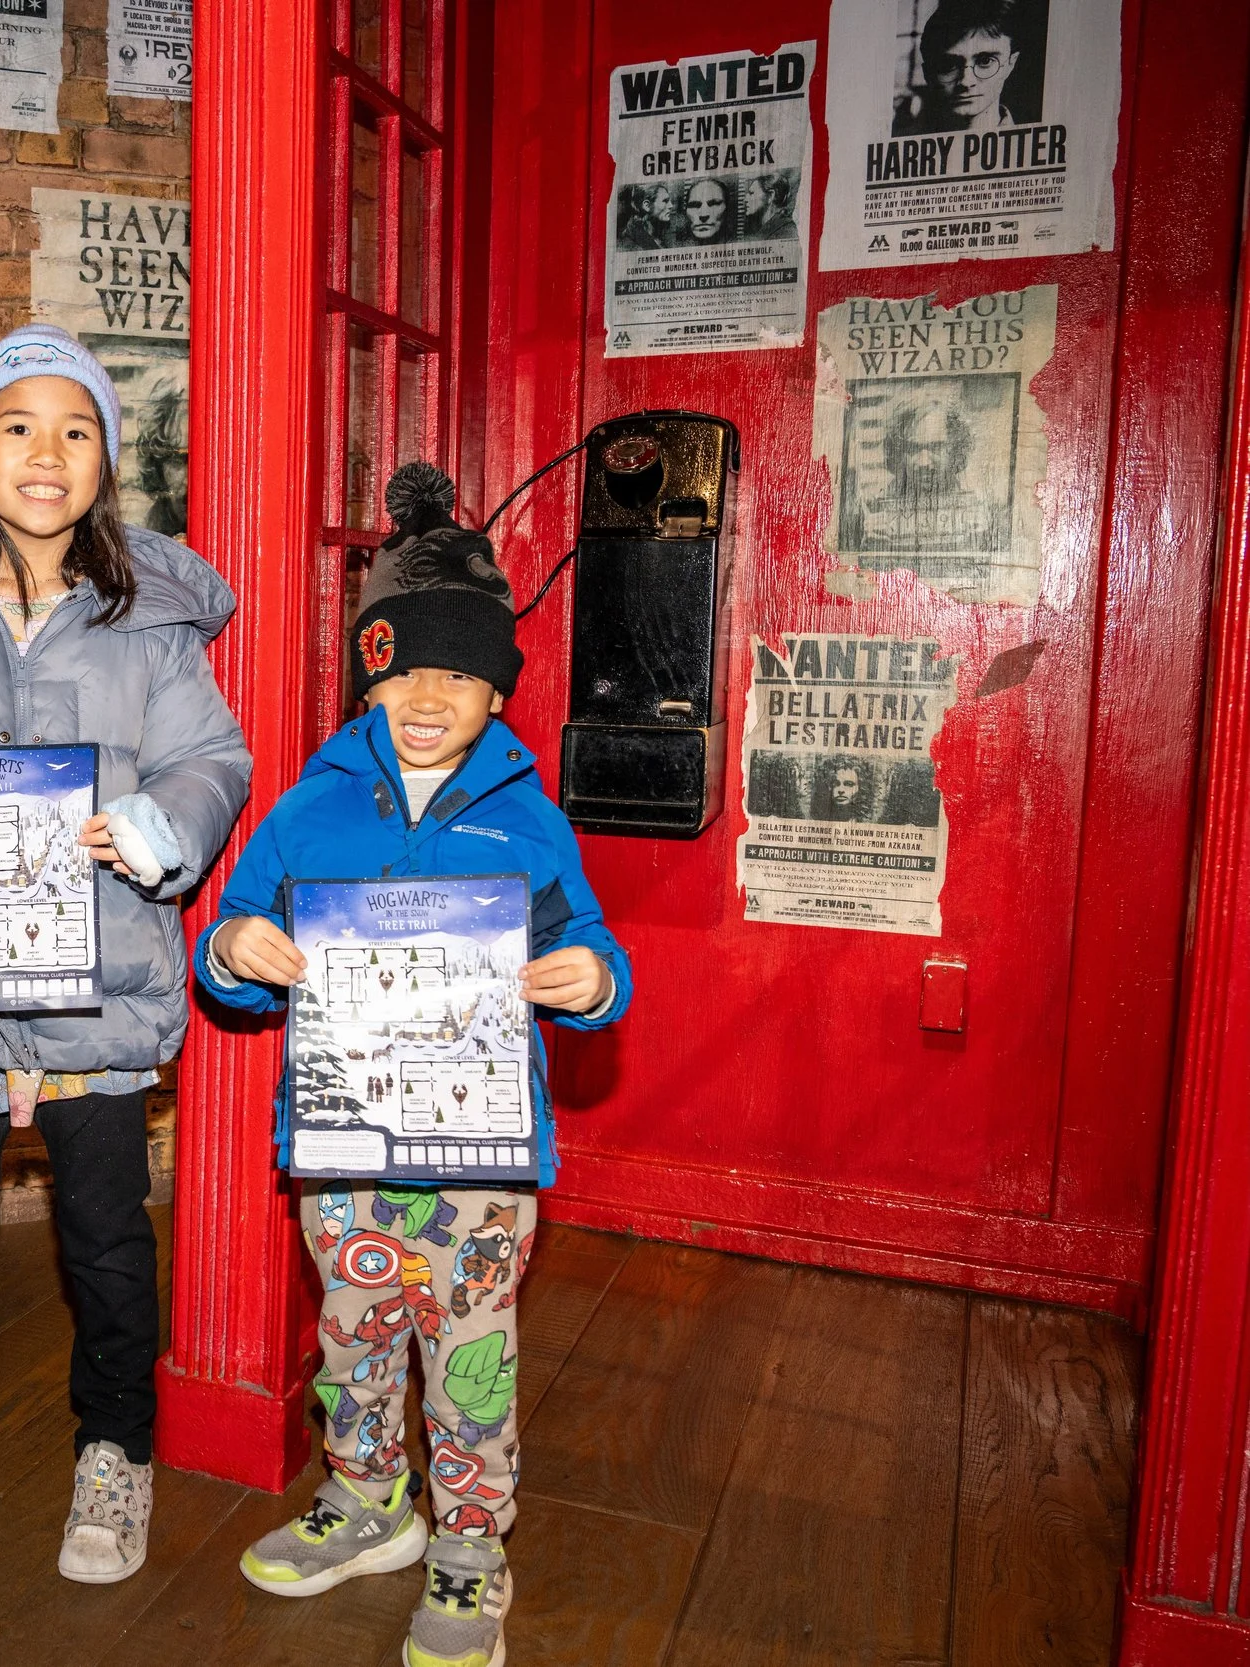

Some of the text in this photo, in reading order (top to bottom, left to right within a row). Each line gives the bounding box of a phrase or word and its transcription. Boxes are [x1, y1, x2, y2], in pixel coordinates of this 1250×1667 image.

[145, 0, 182, 11] DEVIOUS LAW
[620, 53, 805, 112] WANTED
[662, 111, 756, 146] FENRIR
[642, 139, 775, 176] GREYBACK
[866, 124, 1067, 182] HARRY POTTER
[864, 202, 882, 210] HAVE
[885, 201, 898, 209] ANY
[901, 197, 946, 207] INFORMATION
[949, 193, 992, 203] CONCERNING
[1009, 187, 1065, 197] WHEREABOUTS.
[865, 176, 1065, 201] CONTACT THE MINISTRY OF MAGIC IMMEDIATELY IF YOU
[864, 211, 893, 220] FAILING
[908, 207, 935, 216] REPORT
[939, 205, 956, 213] WILL
[960, 202, 988, 211] RESULT
[1002, 196, 1064, 207] IMPRISONMENT.
[928, 222, 991, 238] REWARD
[926, 237, 964, 250] GALLEONS
[968, 237, 978, 247] ON
[982, 235, 995, 246] HIS
[998, 234, 1018, 245] HEAD
[628, 272, 783, 292] APPROACH WITH EXTREME CAUTION!
[95, 288, 191, 332] WIZ
[848, 294, 937, 325] HAVE
[683, 325, 722, 334] REWARD
[848, 318, 1025, 350] SEEN THIS
[858, 345, 1009, 375] WIZARD?
[757, 639, 955, 682] WANTED
[769, 690, 927, 721] BELLATRIX
[769, 721, 924, 751] LESTRANGE
[462, 824, 503, 835] MOUNTAIN
[462, 828, 509, 843] WAREHOUSE
[758, 823, 792, 832] BELLATRIX
[795, 825, 832, 835] LESTRANGE
[901, 833, 925, 841] EATER.
[759, 833, 794, 842] CONVICTED
[836, 838, 865, 847] FUGITIVE
[888, 842, 923, 851] AZKABAN.
[758, 848, 921, 868] APPROACH WITH EXTREME CAUTION!
[366, 890, 450, 912] HOGWARTS
[815, 899, 855, 909] REWARD
[410, 909, 429, 917] SNOW
[377, 919, 439, 930] TREE TRAIL
